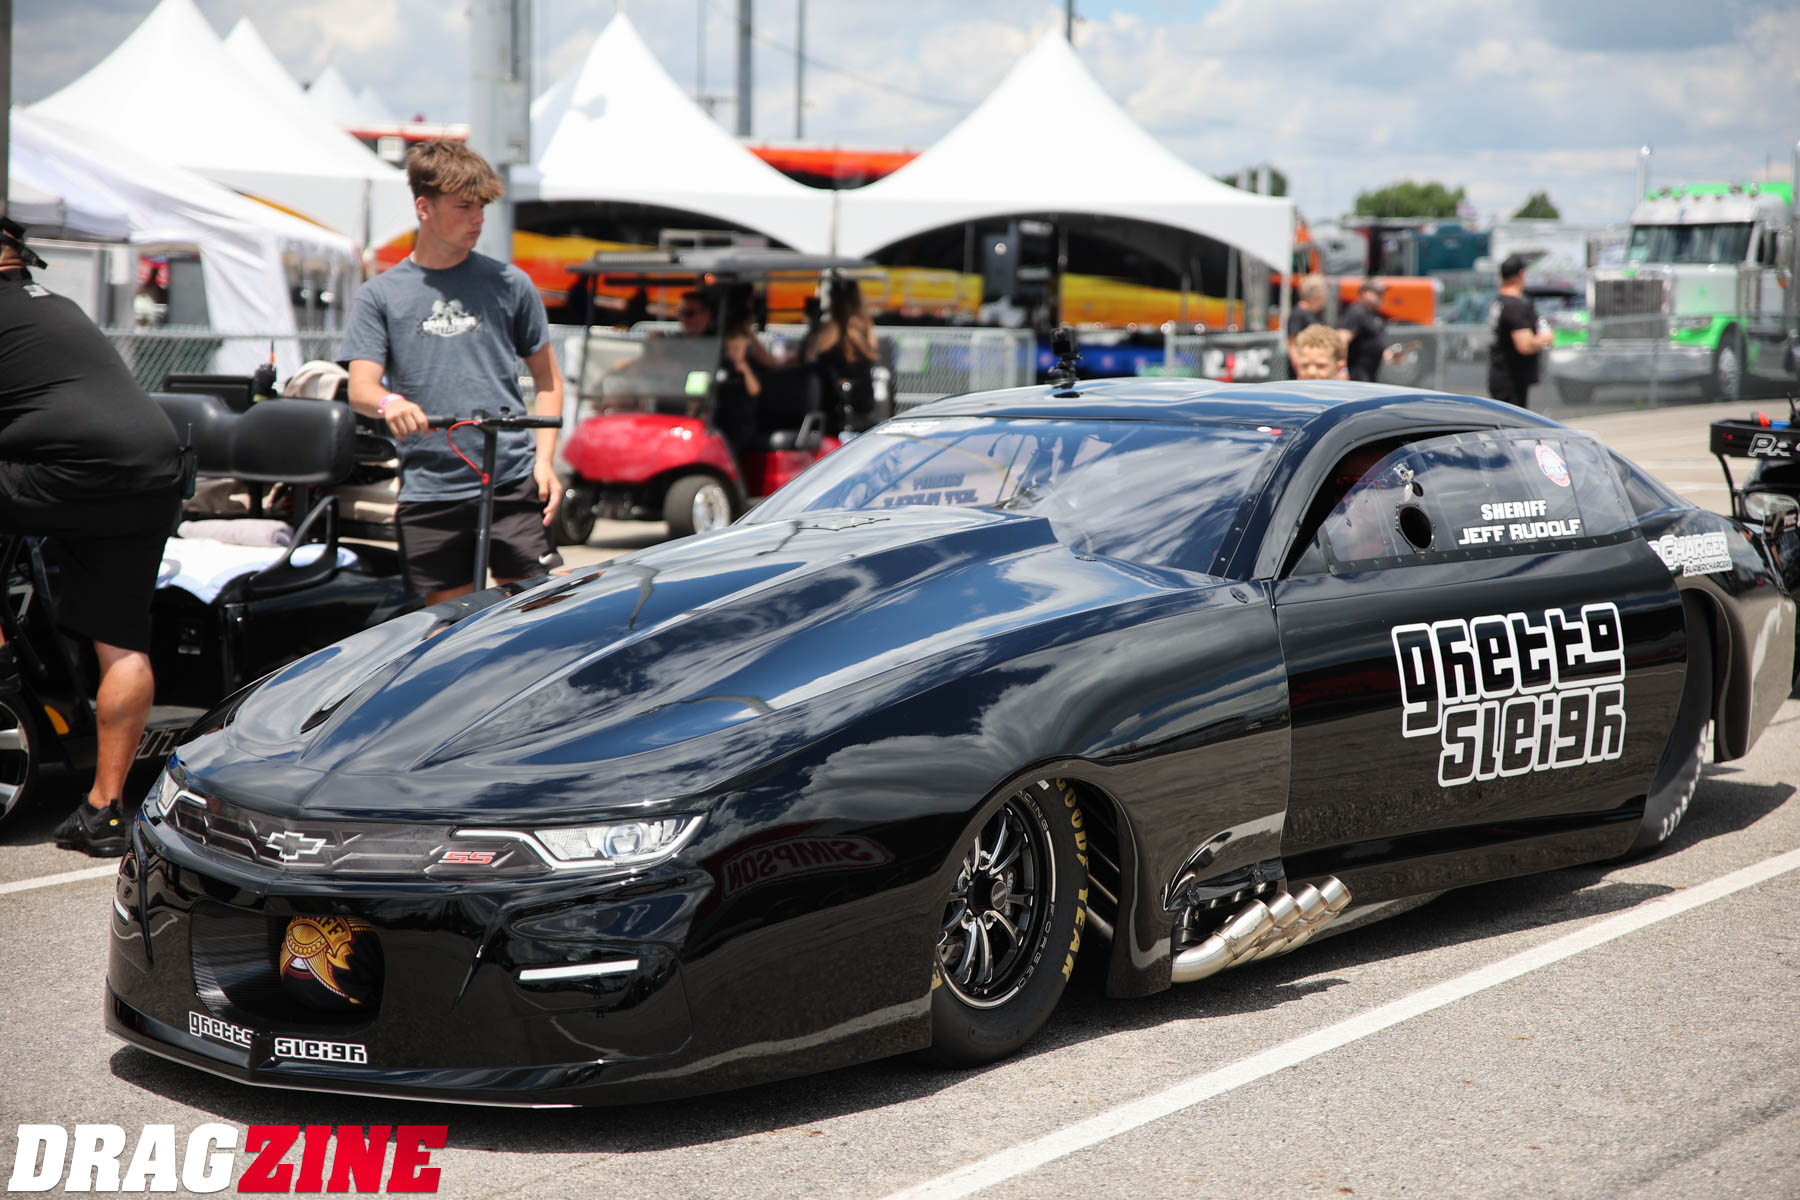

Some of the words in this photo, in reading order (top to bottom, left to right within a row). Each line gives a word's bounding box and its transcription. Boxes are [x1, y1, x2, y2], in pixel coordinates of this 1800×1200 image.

[1480, 500, 1547, 521] SHERIFF
[1458, 525, 1505, 545] JEFF
[1509, 519, 1581, 541] RUDOLF
[1391, 602, 1626, 738] ghetto
[438, 851, 497, 864] SS
[1018, 904, 1056, 988] FORGED
